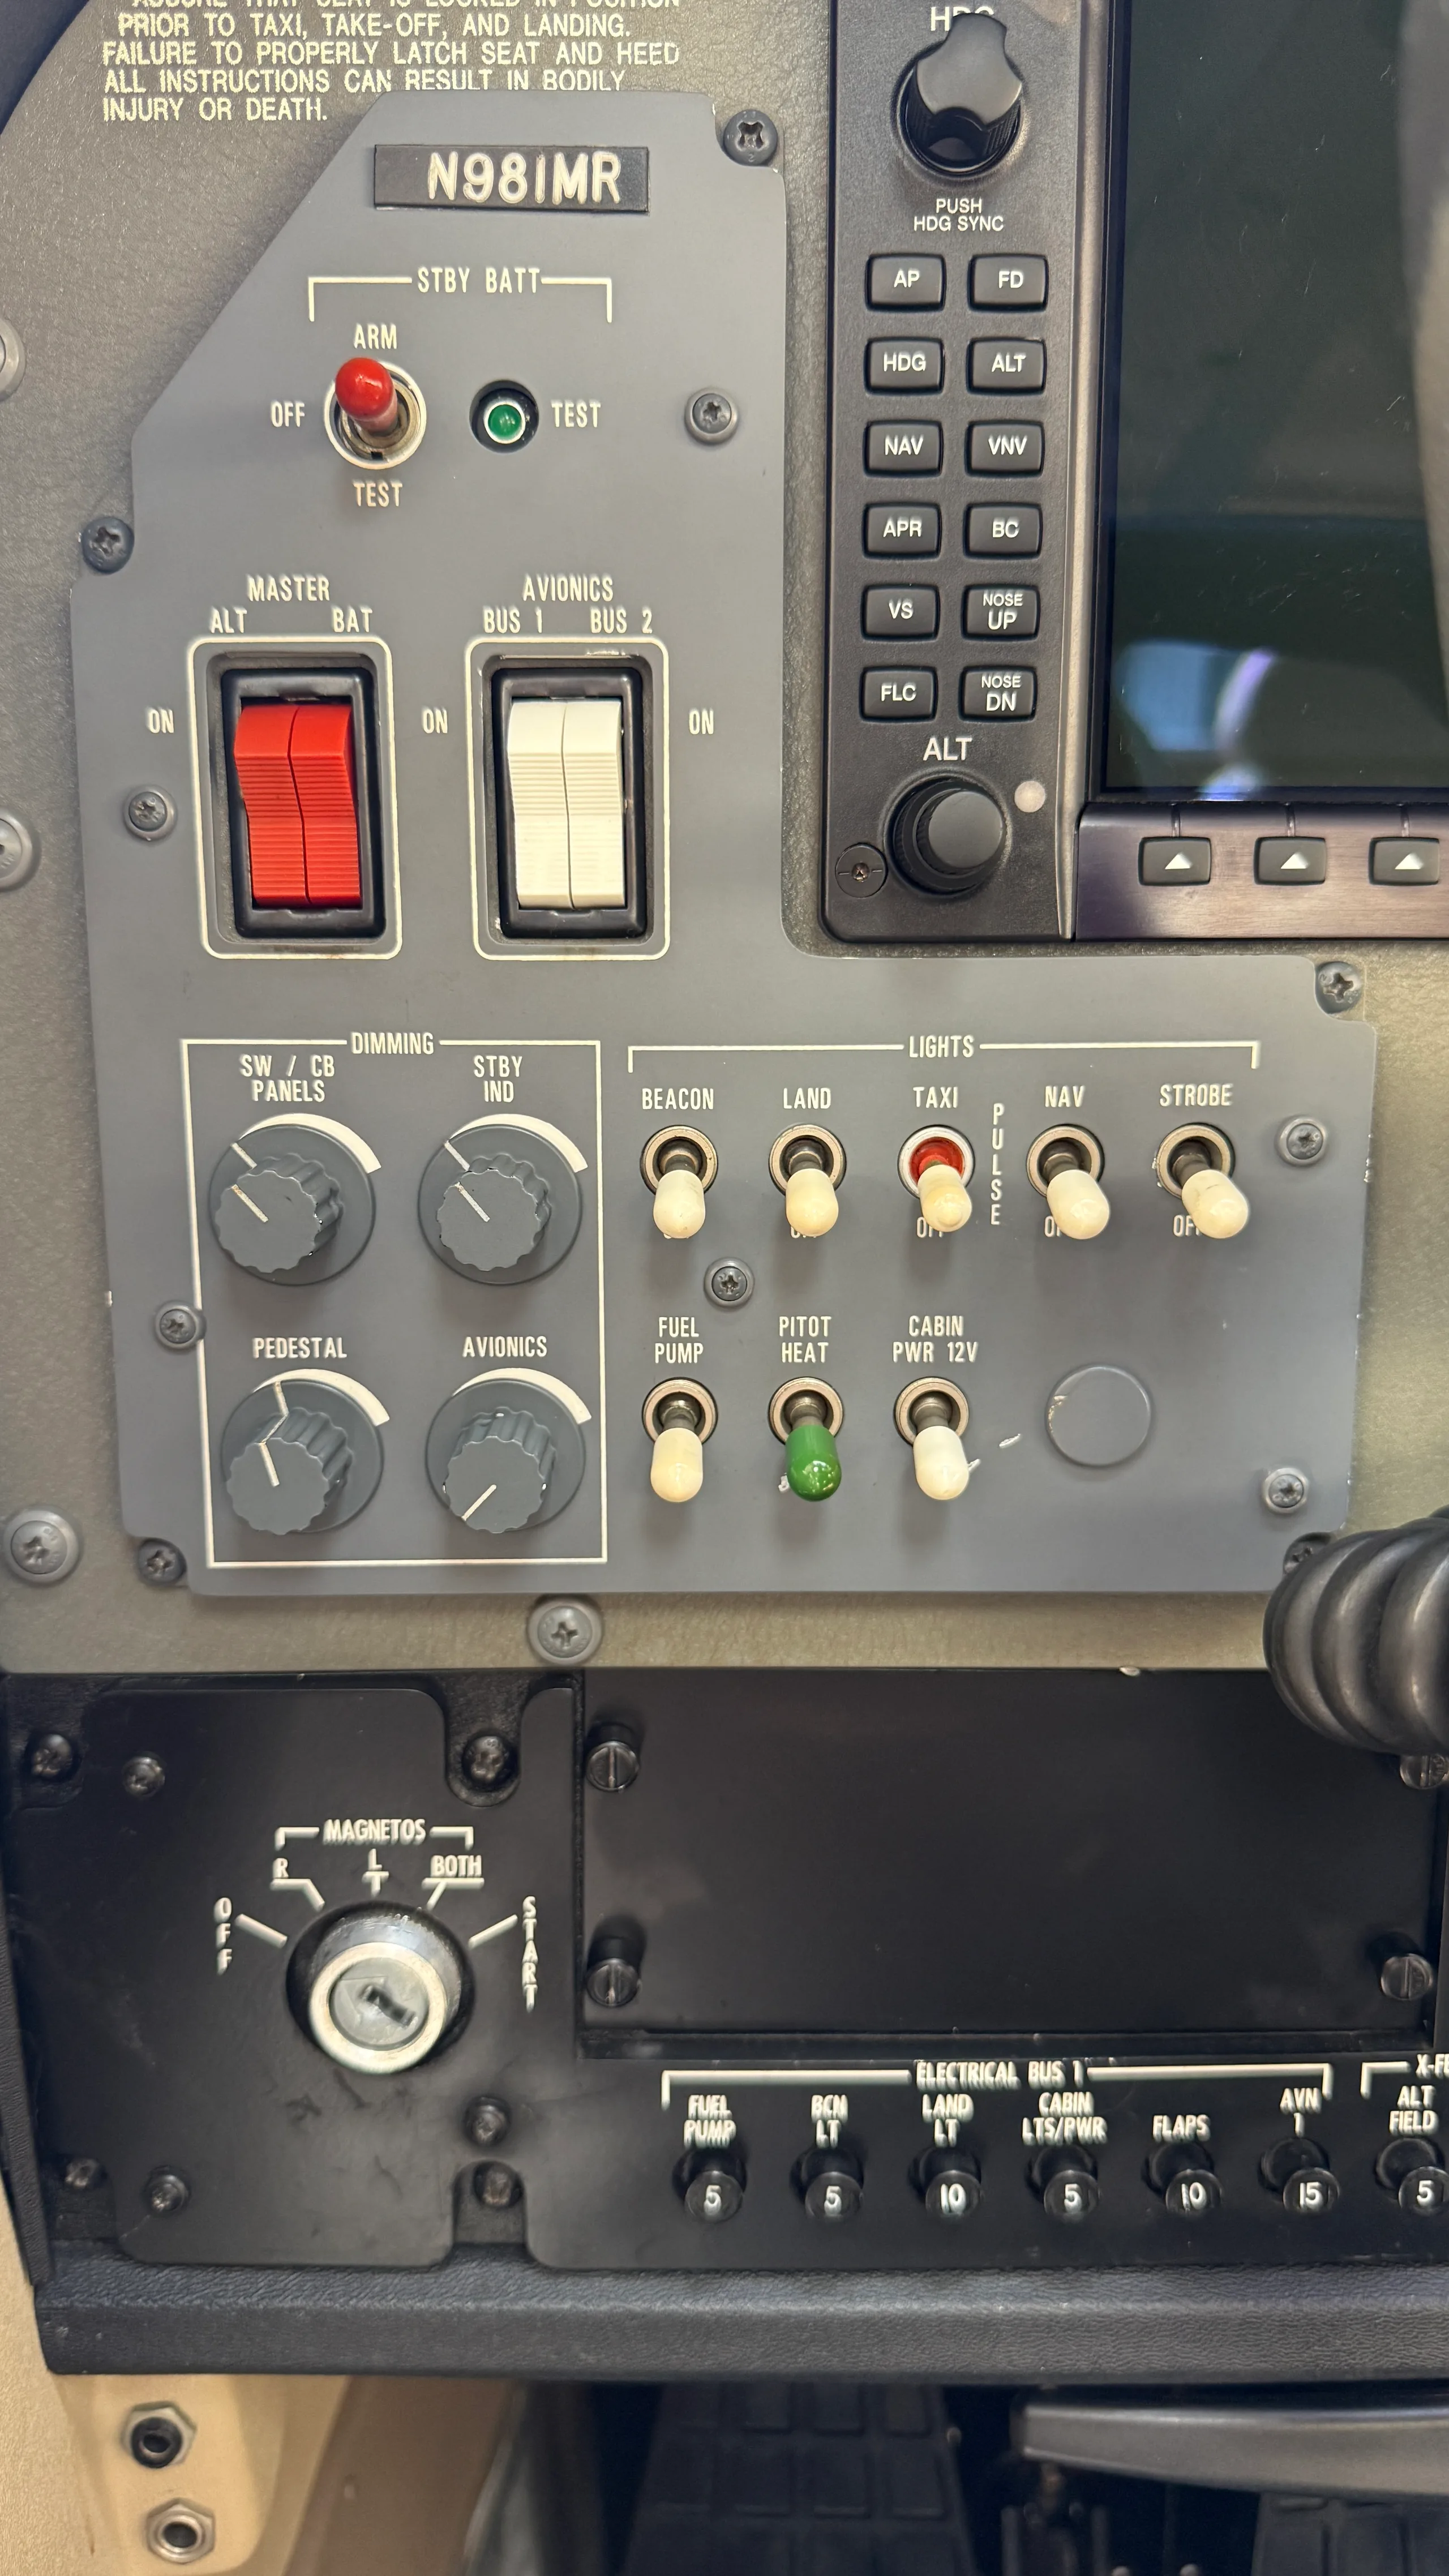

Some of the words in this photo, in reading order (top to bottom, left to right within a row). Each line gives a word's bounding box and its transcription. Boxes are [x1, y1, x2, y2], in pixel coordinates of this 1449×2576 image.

[118, 13, 189, 37] PRIOR
[204, 13, 235, 36] TO
[250, 13, 307, 40] TAXI,
[321, 13, 447, 40] TAKE-OFF,
[463, 13, 509, 36] AND
[525, 14, 630, 36] LANDING.
[102, 41, 196, 65] FAILURE
[211, 41, 242, 65] TO
[257, 41, 378, 65] PROPERLY
[393, 42, 466, 64] LATCH
[482, 41, 540, 64] SEAT
[556, 42, 602, 64] AND
[618, 42, 679, 65] HEED
[105, 70, 146, 93] ALL
[160, 69, 329, 93] INSTRUCTIONS
[344, 69, 391, 92] CAN
[405, 69, 492, 90] RESULT
[508, 70, 528, 90] IN
[543, 69, 625, 91] BODILY
[104, 98, 183, 121] INJURY
[199, 97, 232, 120] OR
[246, 98, 327, 120] DEATH.
[936, 198, 983, 214] PUSH
[914, 215, 951, 232] HDG
[957, 215, 1004, 232] SYNC
[418, 266, 470, 293] STBY
[486, 267, 540, 293] BATT
[894, 269, 920, 288] AP
[998, 270, 1024, 289] FD
[353, 323, 397, 349] ARM
[884, 352, 927, 372] HDG
[991, 353, 1026, 372] ALT
[271, 401, 305, 427] OFF
[551, 400, 601, 428] TEST
[885, 435, 924, 455] NAV
[988, 435, 1027, 455] VNV
[353, 481, 403, 507] TEST
[883, 518, 922, 537] APR
[992, 519, 1019, 538] BC
[247, 575, 330, 602] MASTER
[522, 575, 614, 602] AVIONICS
[983, 592, 1023, 607] NOSE
[209, 607, 247, 633] ALT
[332, 606, 373, 632] BAT
[483, 606, 521, 633] BUS
[535, 607, 542, 633] 1
[590, 606, 627, 633] BUS
[642, 607, 653, 634] 2
[889, 599, 914, 619] VS
[988, 608, 1017, 630] UP
[881, 683, 916, 701] FLC
[981, 674, 1021, 688] NOSE
[986, 691, 1017, 711] DN
[147, 708, 174, 734] ON
[422, 708, 448, 734] ON
[689, 709, 714, 735] ON
[923, 736, 973, 761] ALT
[351, 1032, 434, 1055] DIMMING
[909, 1035, 974, 1058] LIGHTS
[240, 1054, 272, 1077] SW
[311, 1055, 335, 1077] CB
[474, 1055, 522, 1078] STBY
[252, 1079, 325, 1103] PANELS
[484, 1080, 514, 1103] IND
[642, 1087, 714, 1110] BEACON
[783, 1087, 831, 1109] LAND
[912, 1086, 958, 1108] TAXI
[1045, 1085, 1084, 1108] NAV
[1160, 1083, 1232, 1107] STROBE
[991, 1103, 1005, 1225] PULSE
[658, 1317, 700, 1338] FUEL
[779, 1315, 832, 1338] PITOT
[909, 1315, 963, 1337] CABIN
[253, 1337, 348, 1358] PEDESTAL
[462, 1335, 547, 1358] AVIONICS
[655, 1343, 704, 1364] PUMP
[782, 1341, 829, 1363] HEAT
[893, 1341, 934, 1363] PWR
[947, 1341, 978, 1362] 12V
[323, 1819, 426, 1844] MAGNETOS
[272, 1858, 289, 1879] R
[368, 1848, 383, 1871] L
[430, 1854, 482, 1876] BOTH
[214, 1897, 233, 1973] OFF
[522, 1896, 538, 2010] START
[916, 2061, 1019, 2086] ELECTRICAL
[1028, 2060, 1065, 2086] BUS
[1072, 2060, 1083, 2084] 1
[688, 2094, 732, 2118] FUEL
[811, 2094, 848, 2119] BCN
[922, 2093, 974, 2119] LAND
[1039, 2091, 1093, 2115] CABIN
[1280, 2087, 1321, 2110] AVN
[1397, 2085, 1434, 2107] ALT
[683, 2119, 736, 2144] PUMP
[814, 2119, 841, 2144] LT
[934, 2118, 959, 2143] LT
[1022, 2116, 1106, 2143] LTS/PWR
[1152, 2114, 1209, 2139] FLAPS
[1293, 2112, 1304, 2134] 1
[1389, 2110, 1438, 2132] FIELD
[704, 2184, 722, 2214] 5
[824, 2185, 842, 2211] 5
[940, 2183, 966, 2212] 10
[1064, 2183, 1082, 2209] 5
[1181, 2181, 1206, 2209] 10
[1300, 2181, 1322, 2206] 15
[1416, 2180, 1434, 2204] 5
